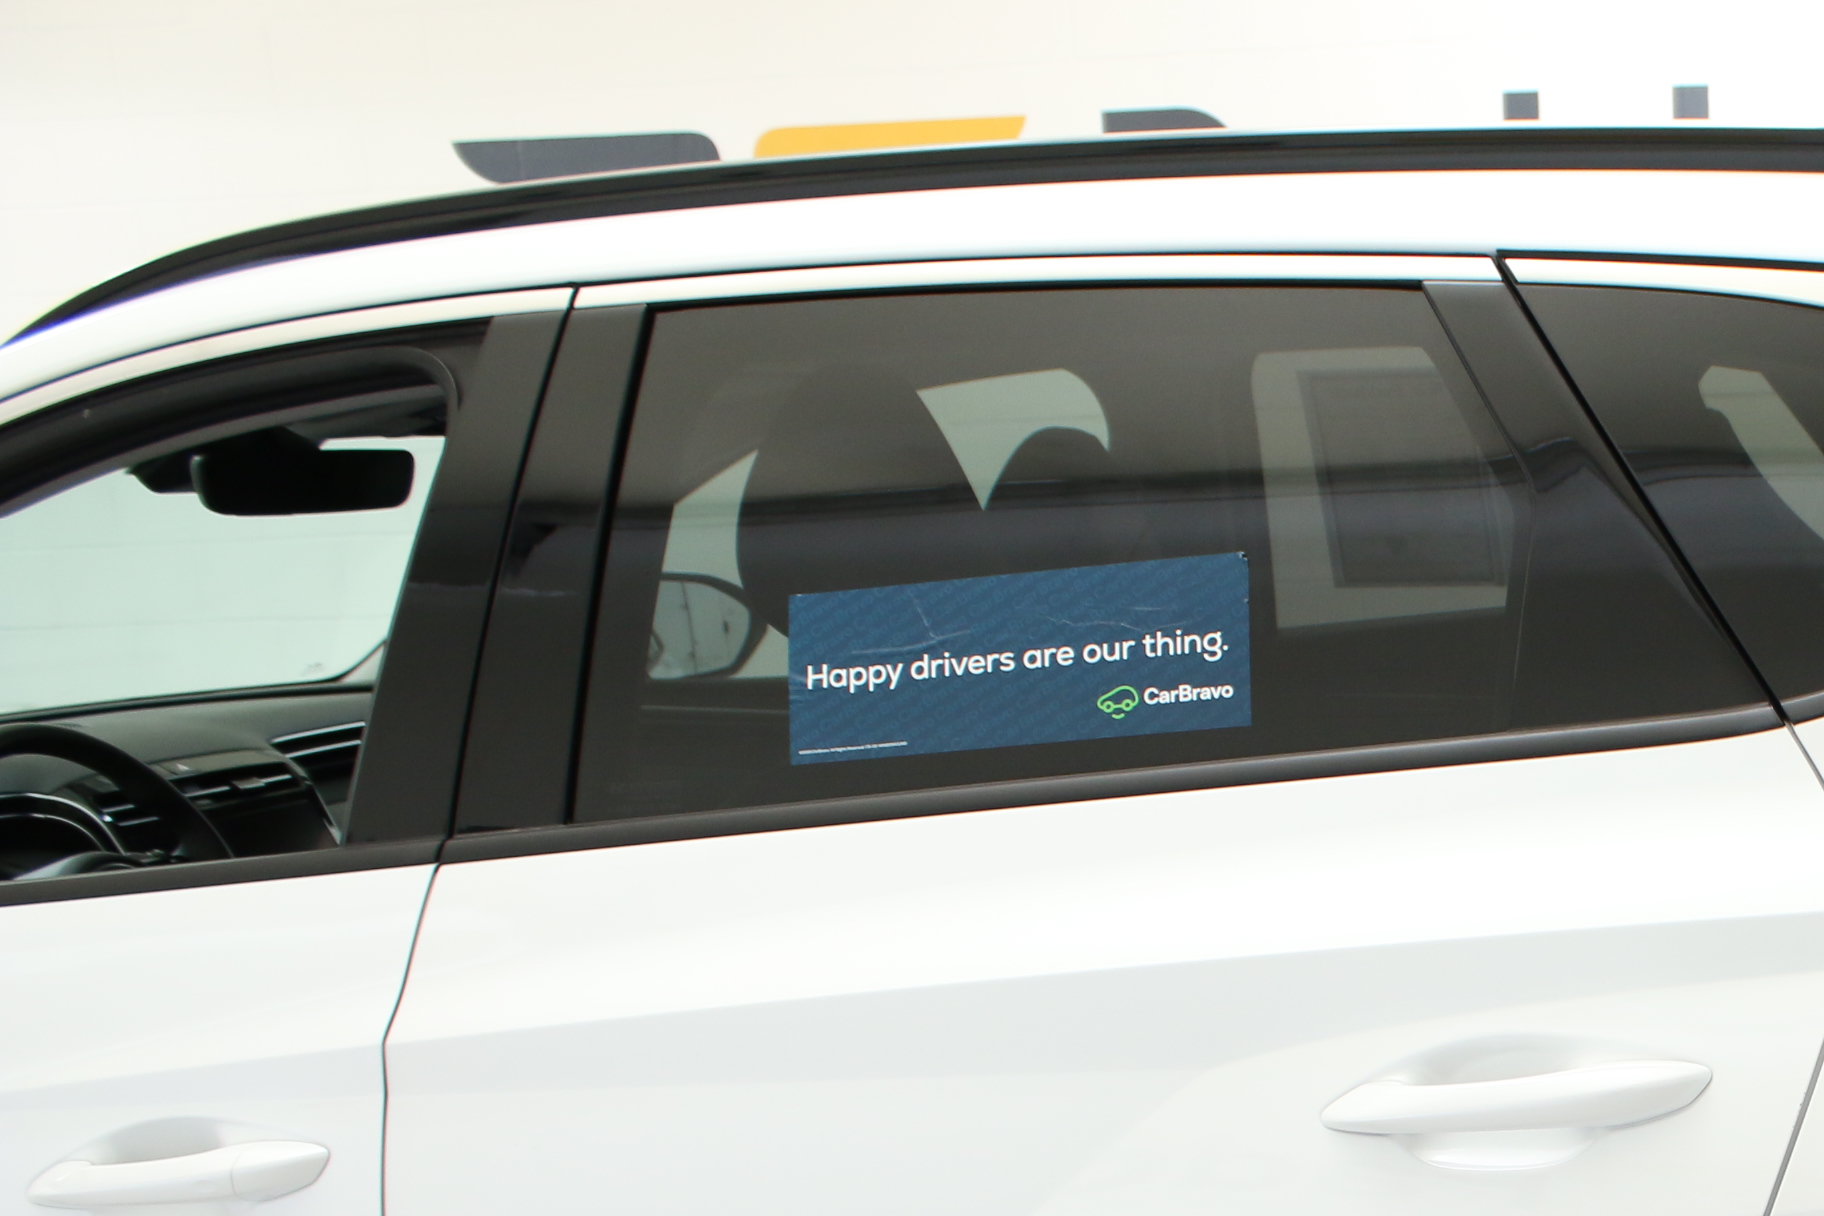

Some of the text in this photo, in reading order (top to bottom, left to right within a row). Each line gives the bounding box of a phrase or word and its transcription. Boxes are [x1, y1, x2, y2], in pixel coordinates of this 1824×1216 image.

[806, 629, 1229, 694] Happy drivers are our thing.
[1143, 683, 1235, 705] CarBravo
